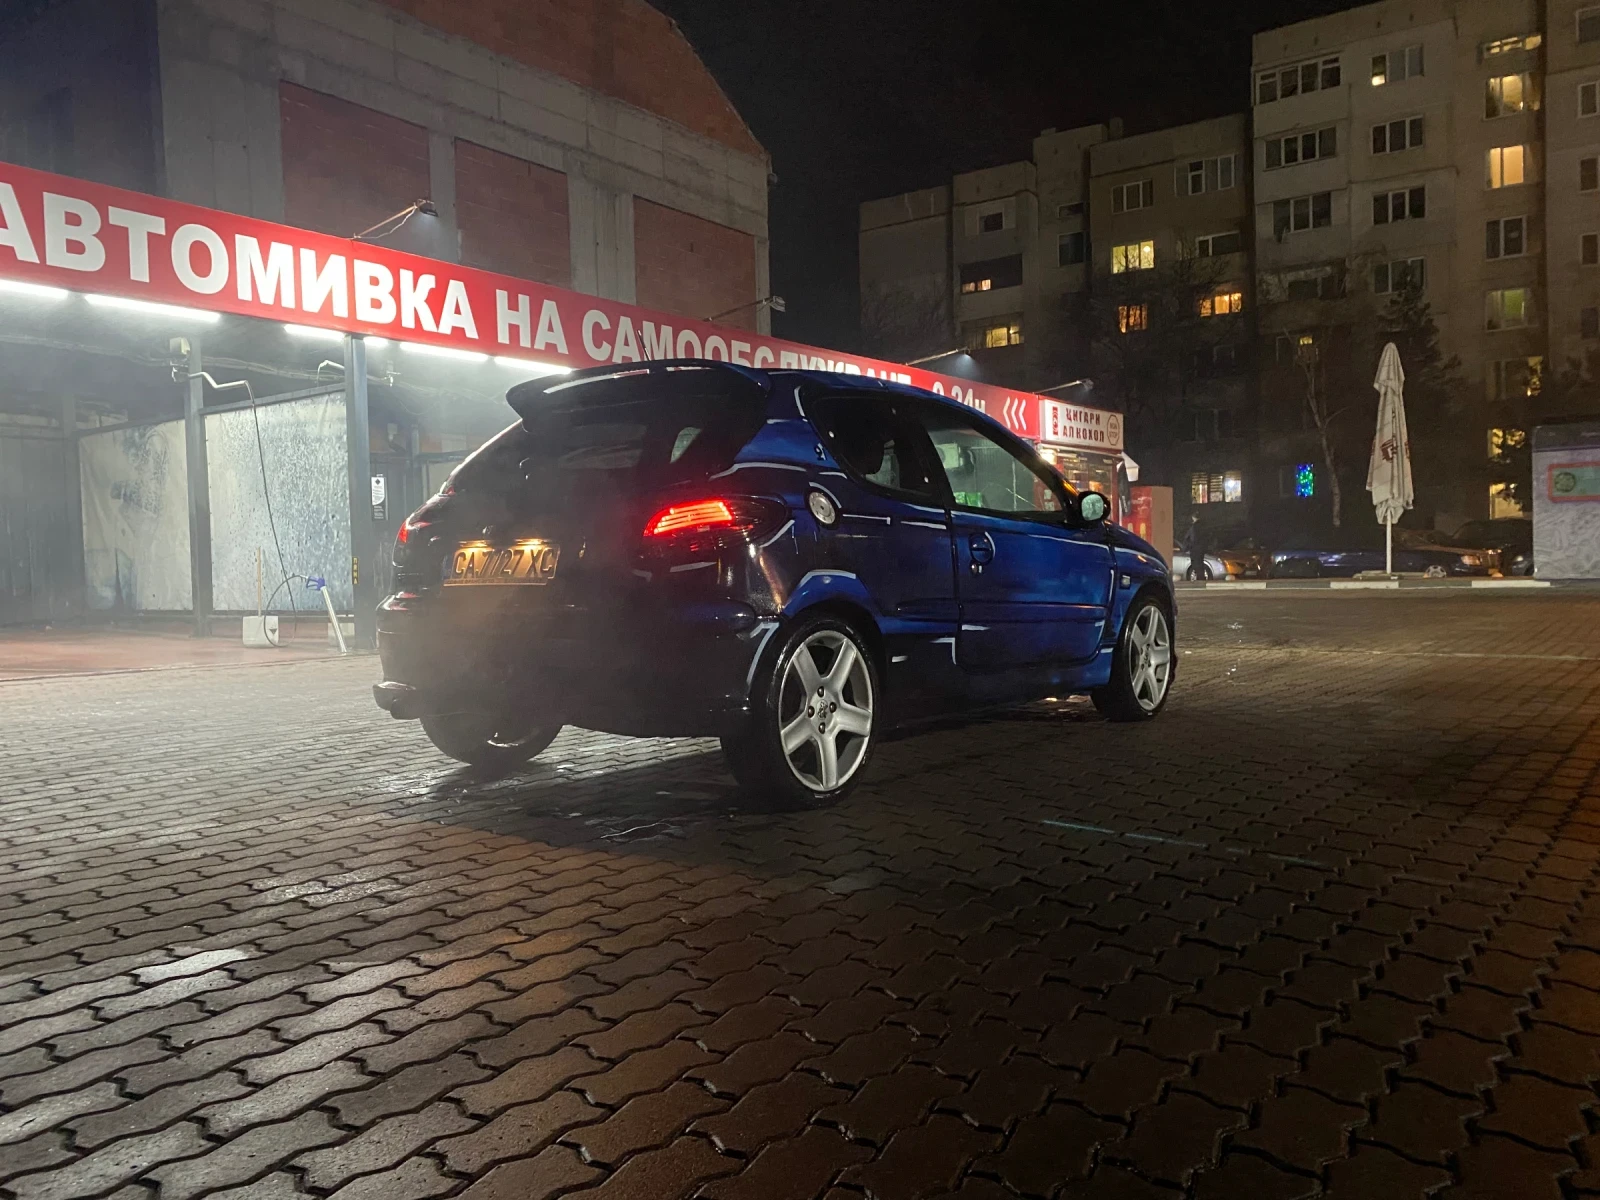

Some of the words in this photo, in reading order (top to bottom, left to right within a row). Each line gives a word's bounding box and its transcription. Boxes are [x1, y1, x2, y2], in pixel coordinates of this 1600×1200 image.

[0, 183, 478, 340] АВТОМИВКА
[496, 289, 569, 356] НА
[1066, 408, 1100, 426] ЦИГАРИ
[1063, 425, 1105, 442] АЛКОХОЛ
